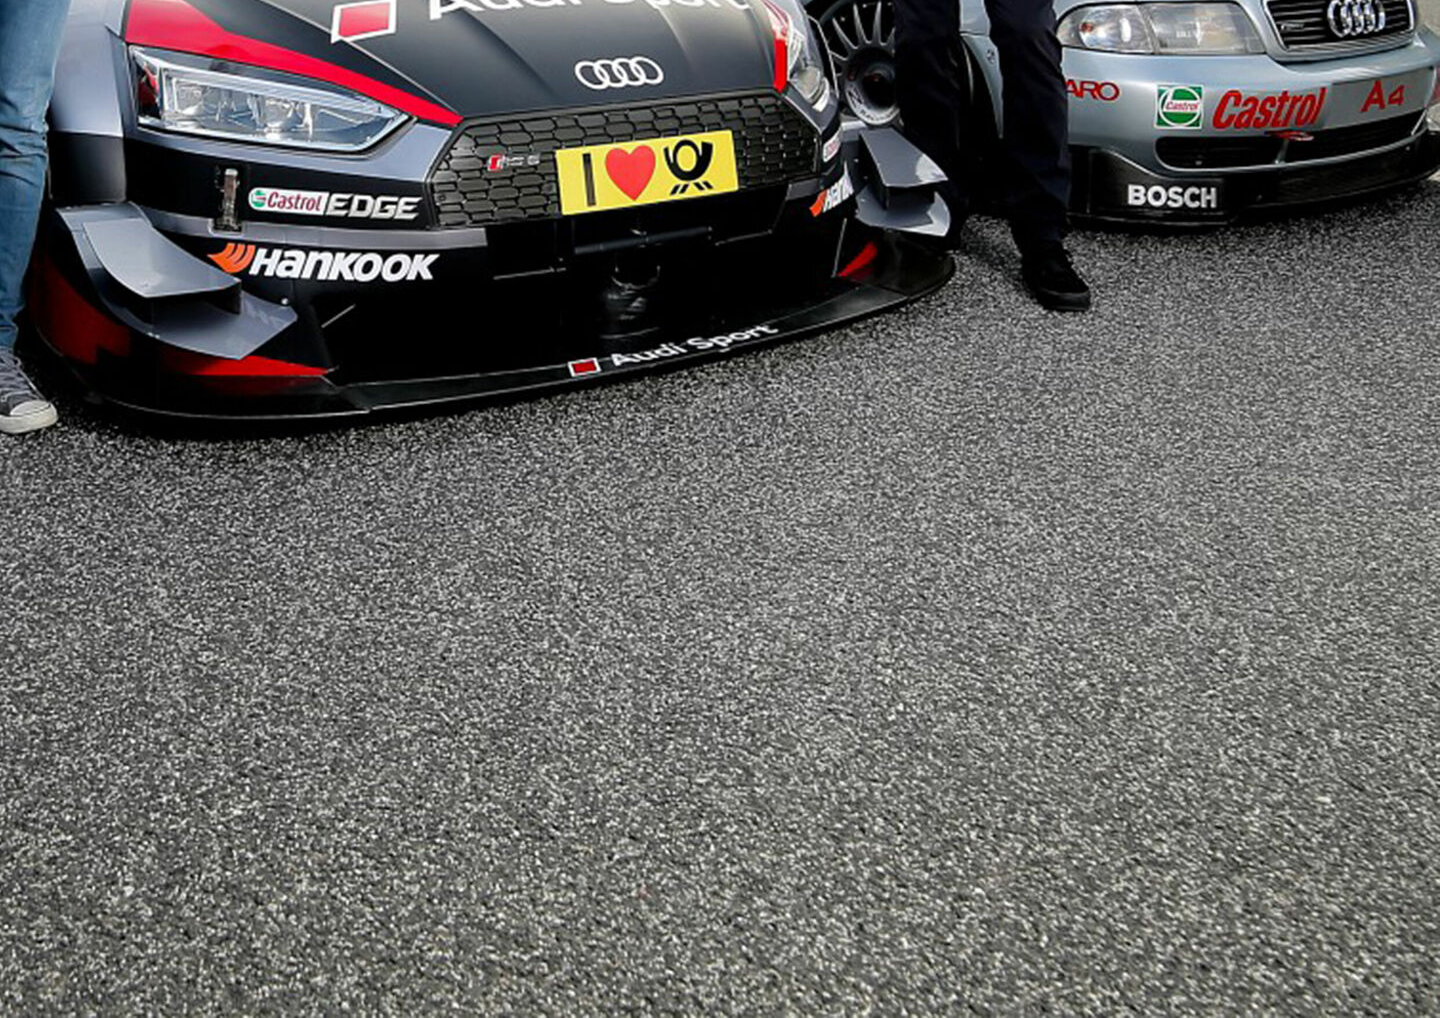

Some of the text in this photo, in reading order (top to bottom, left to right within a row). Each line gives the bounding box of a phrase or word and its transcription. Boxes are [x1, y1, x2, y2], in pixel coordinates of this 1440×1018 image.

[1164, 100, 1201, 111] Castrol
[1212, 86, 1327, 129] Castrol
[1361, 79, 1405, 113] A4
[582, 152, 597, 207] I
[1127, 184, 1218, 209] BOSCH
[266, 191, 422, 220] Castrol EDGE
[610, 325, 780, 367] Audi Sport
